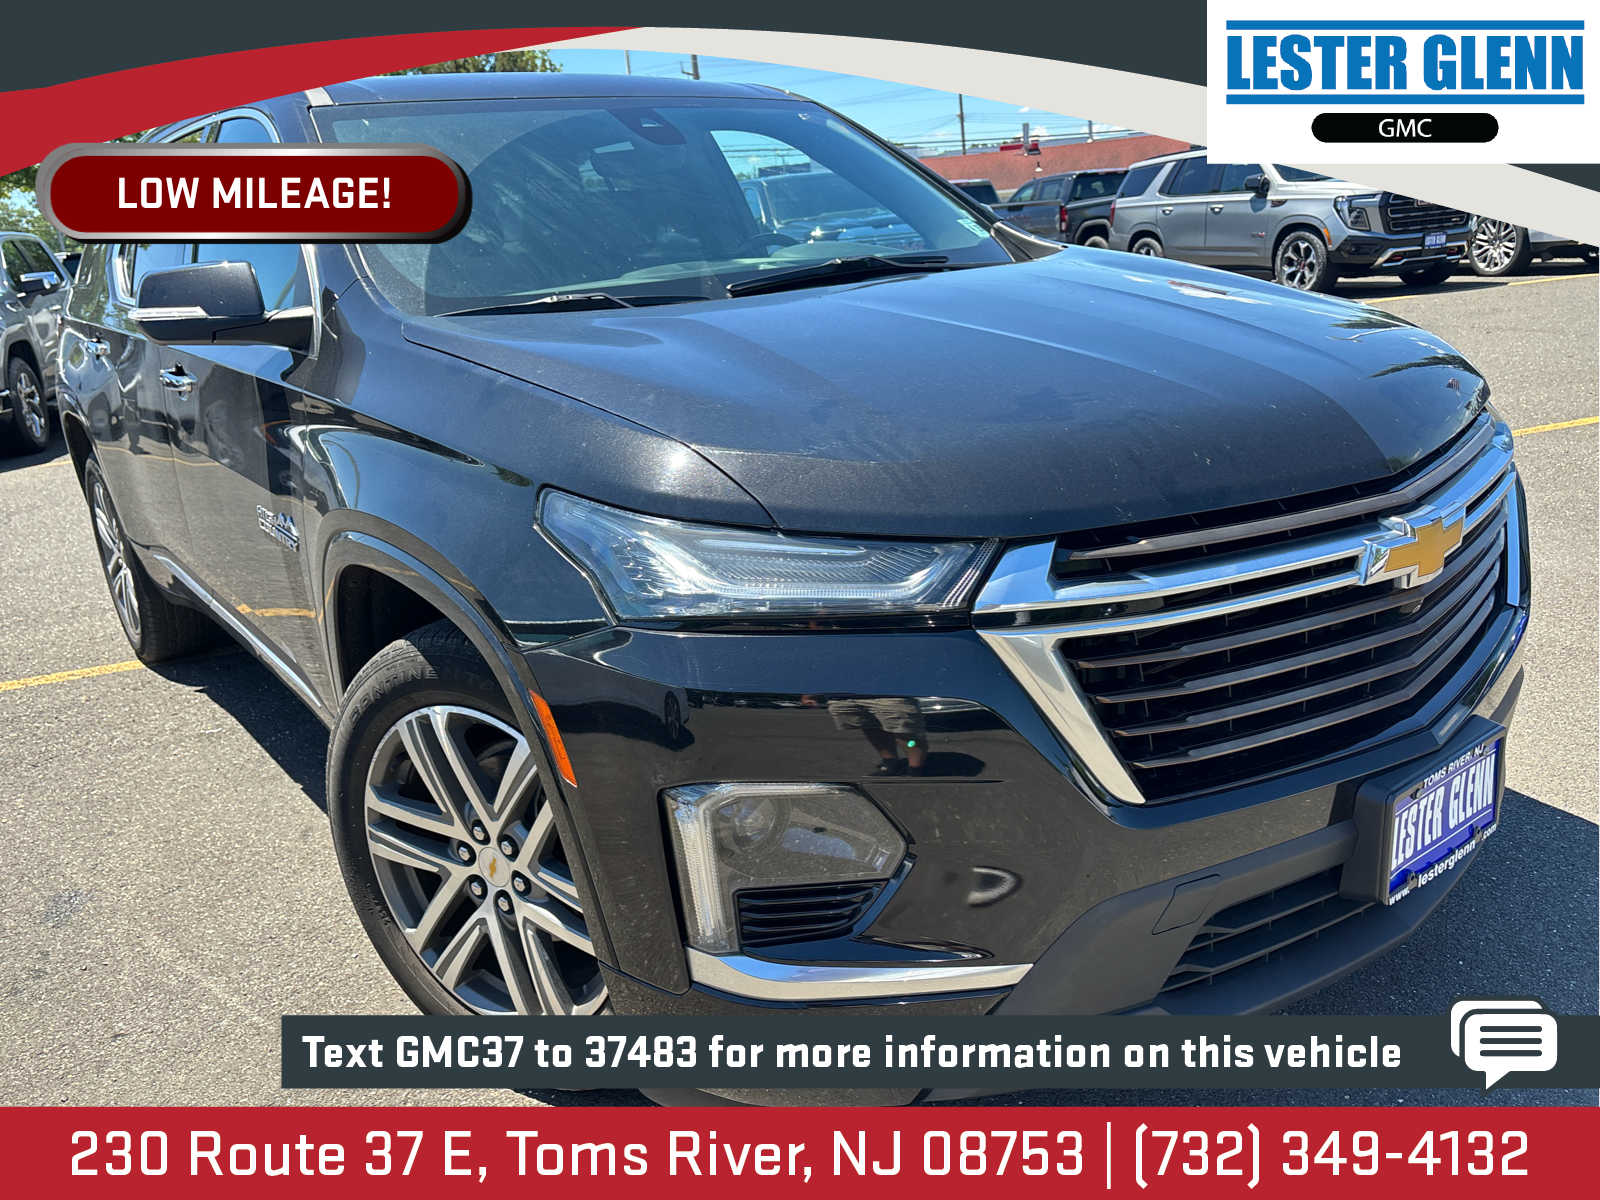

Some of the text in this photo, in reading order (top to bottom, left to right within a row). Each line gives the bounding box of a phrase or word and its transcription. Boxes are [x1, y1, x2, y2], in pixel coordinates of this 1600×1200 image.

[1423, 766, 1447, 789] TOMS
[1474, 743, 1485, 758] NJ
[1391, 753, 1496, 872] LESTER GLENN
